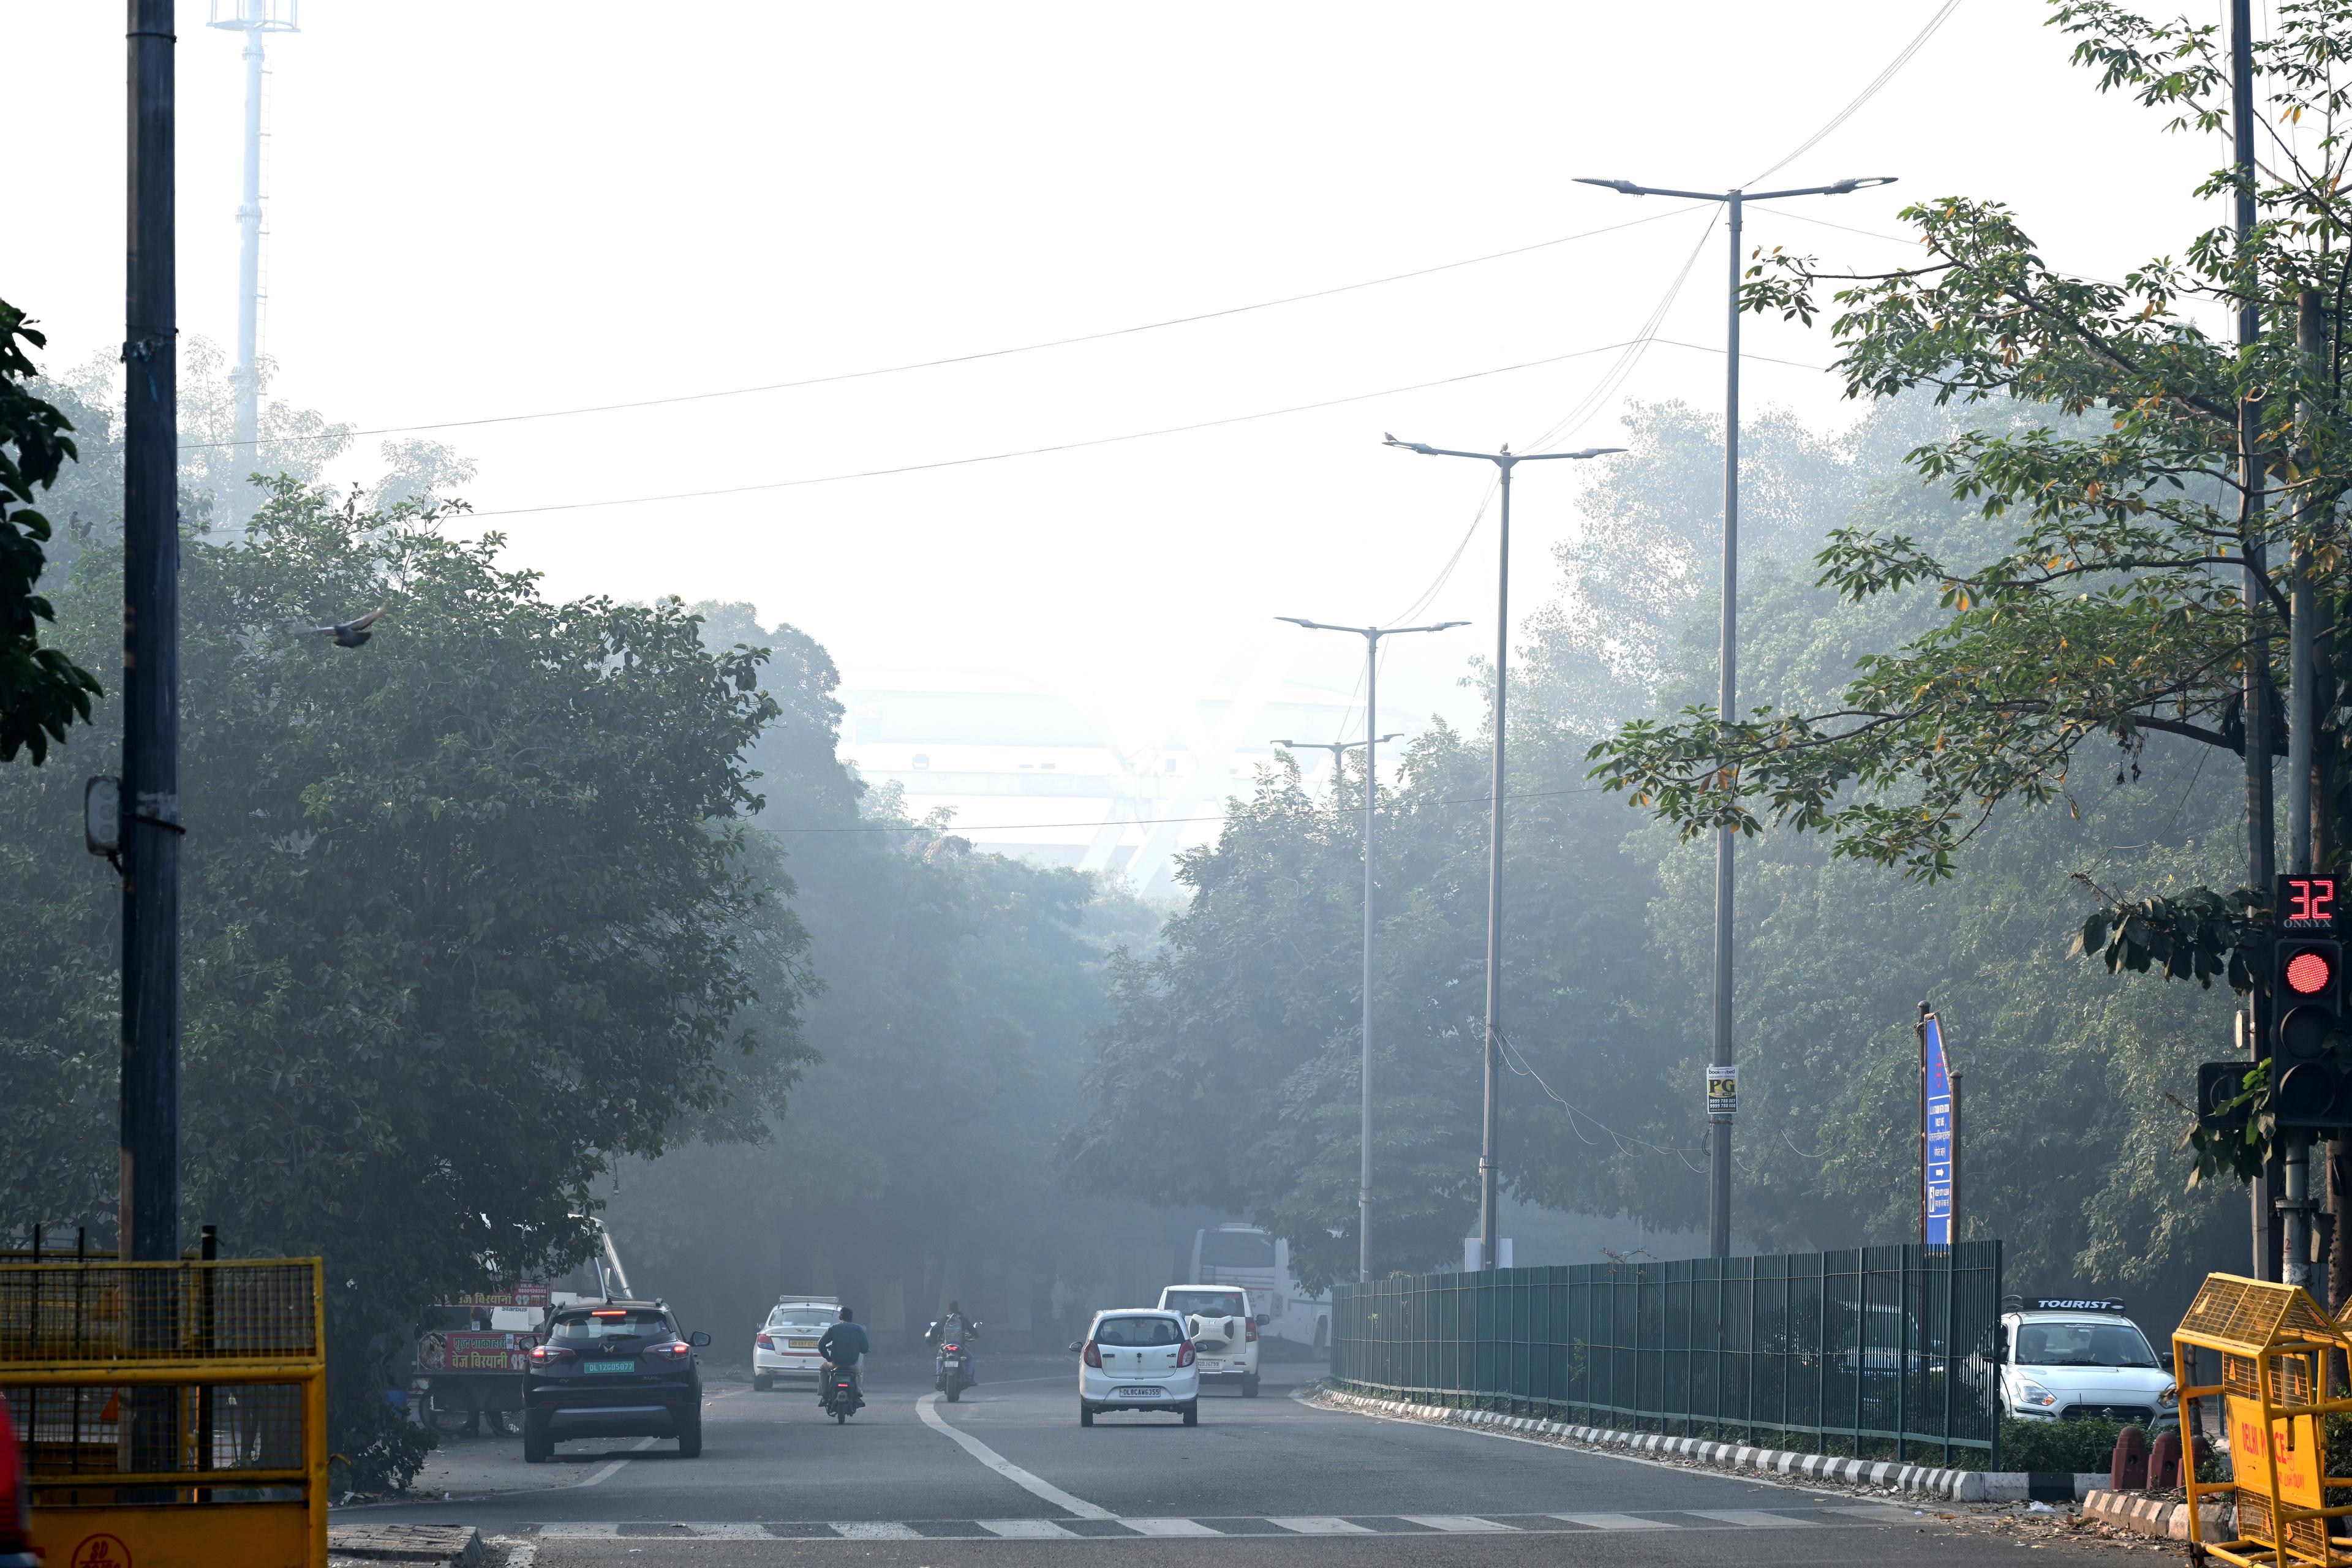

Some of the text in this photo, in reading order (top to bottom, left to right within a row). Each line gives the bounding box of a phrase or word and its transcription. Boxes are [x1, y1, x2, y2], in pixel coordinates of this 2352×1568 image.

[2289, 880, 2333, 919] 32
[1709, 1079, 1735, 1093] PG
[2038, 1300, 2111, 1309] TOURIST
[452, 1351, 508, 1368] वेज बिरयानी
[2242, 1421, 2287, 1464] DELHI PCE
